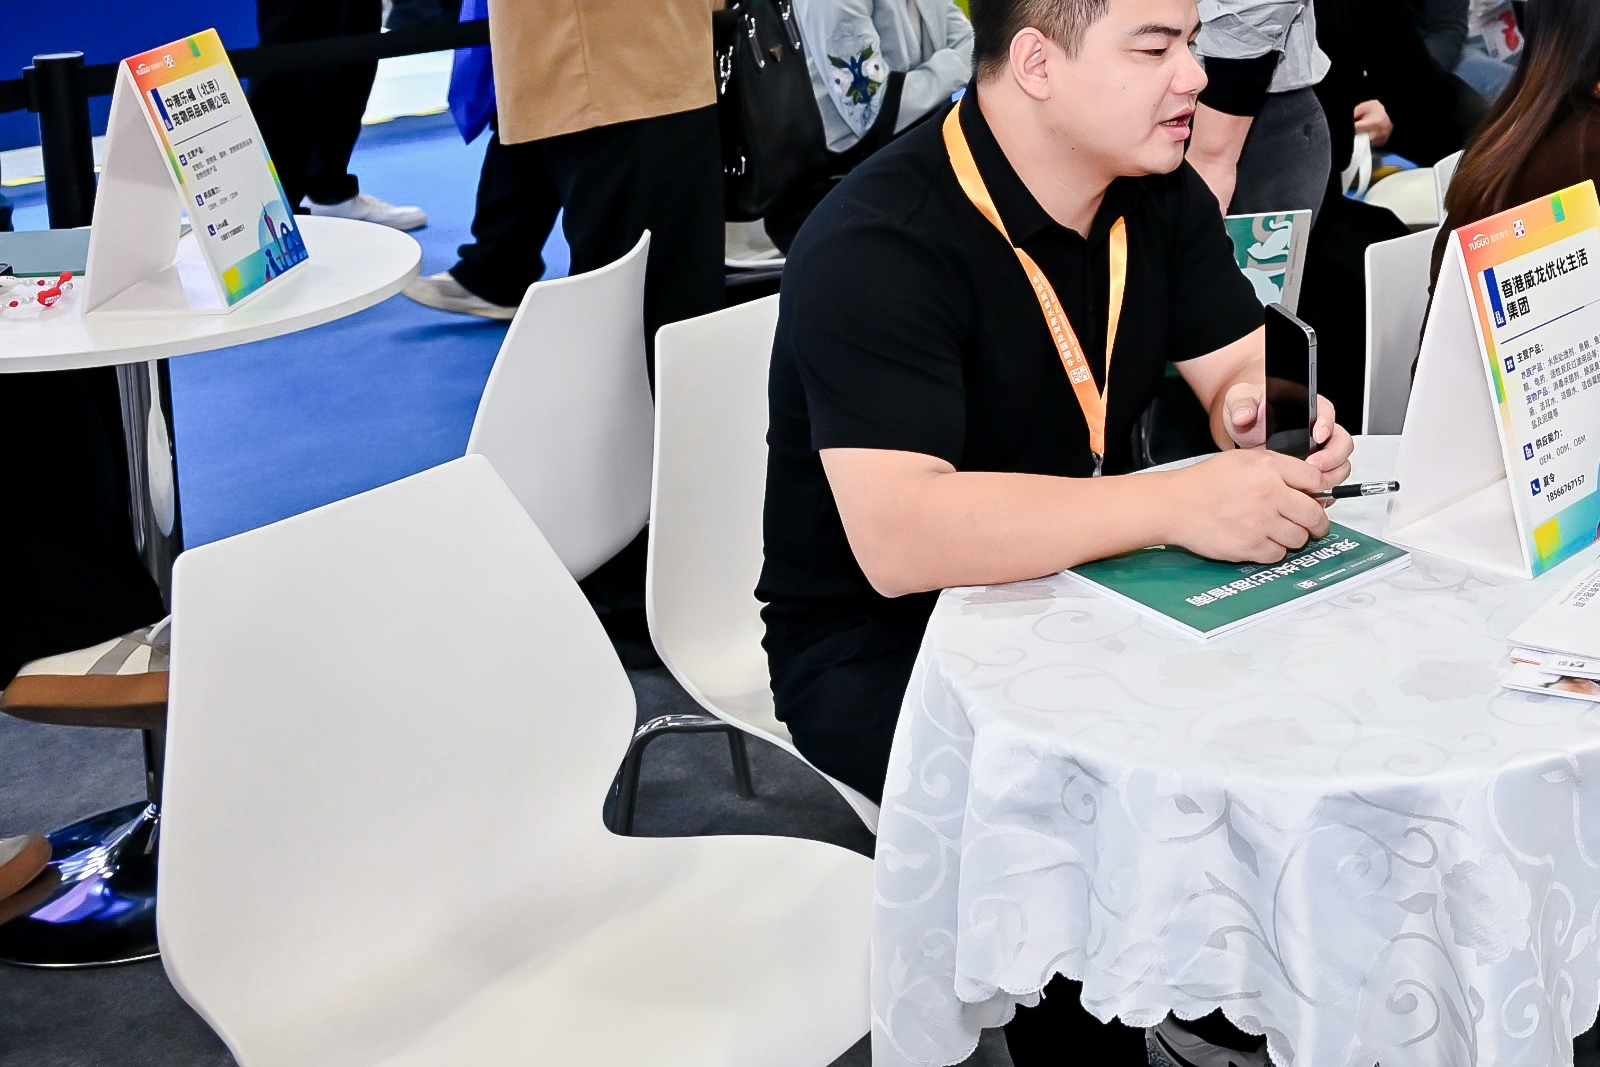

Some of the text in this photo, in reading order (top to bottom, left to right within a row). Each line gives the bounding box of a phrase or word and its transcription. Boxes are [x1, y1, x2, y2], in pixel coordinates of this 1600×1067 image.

[1501, 248, 1589, 299] 香港威龙优化生活
[1506, 296, 1531, 321] 集团
[1517, 343, 1544, 364] 主营产品：
[1535, 429, 1563, 450] 供应能力：
[1546, 474, 1585, 503] 18566767157
[1185, 538, 1361, 608] 宠物品类出海指南
